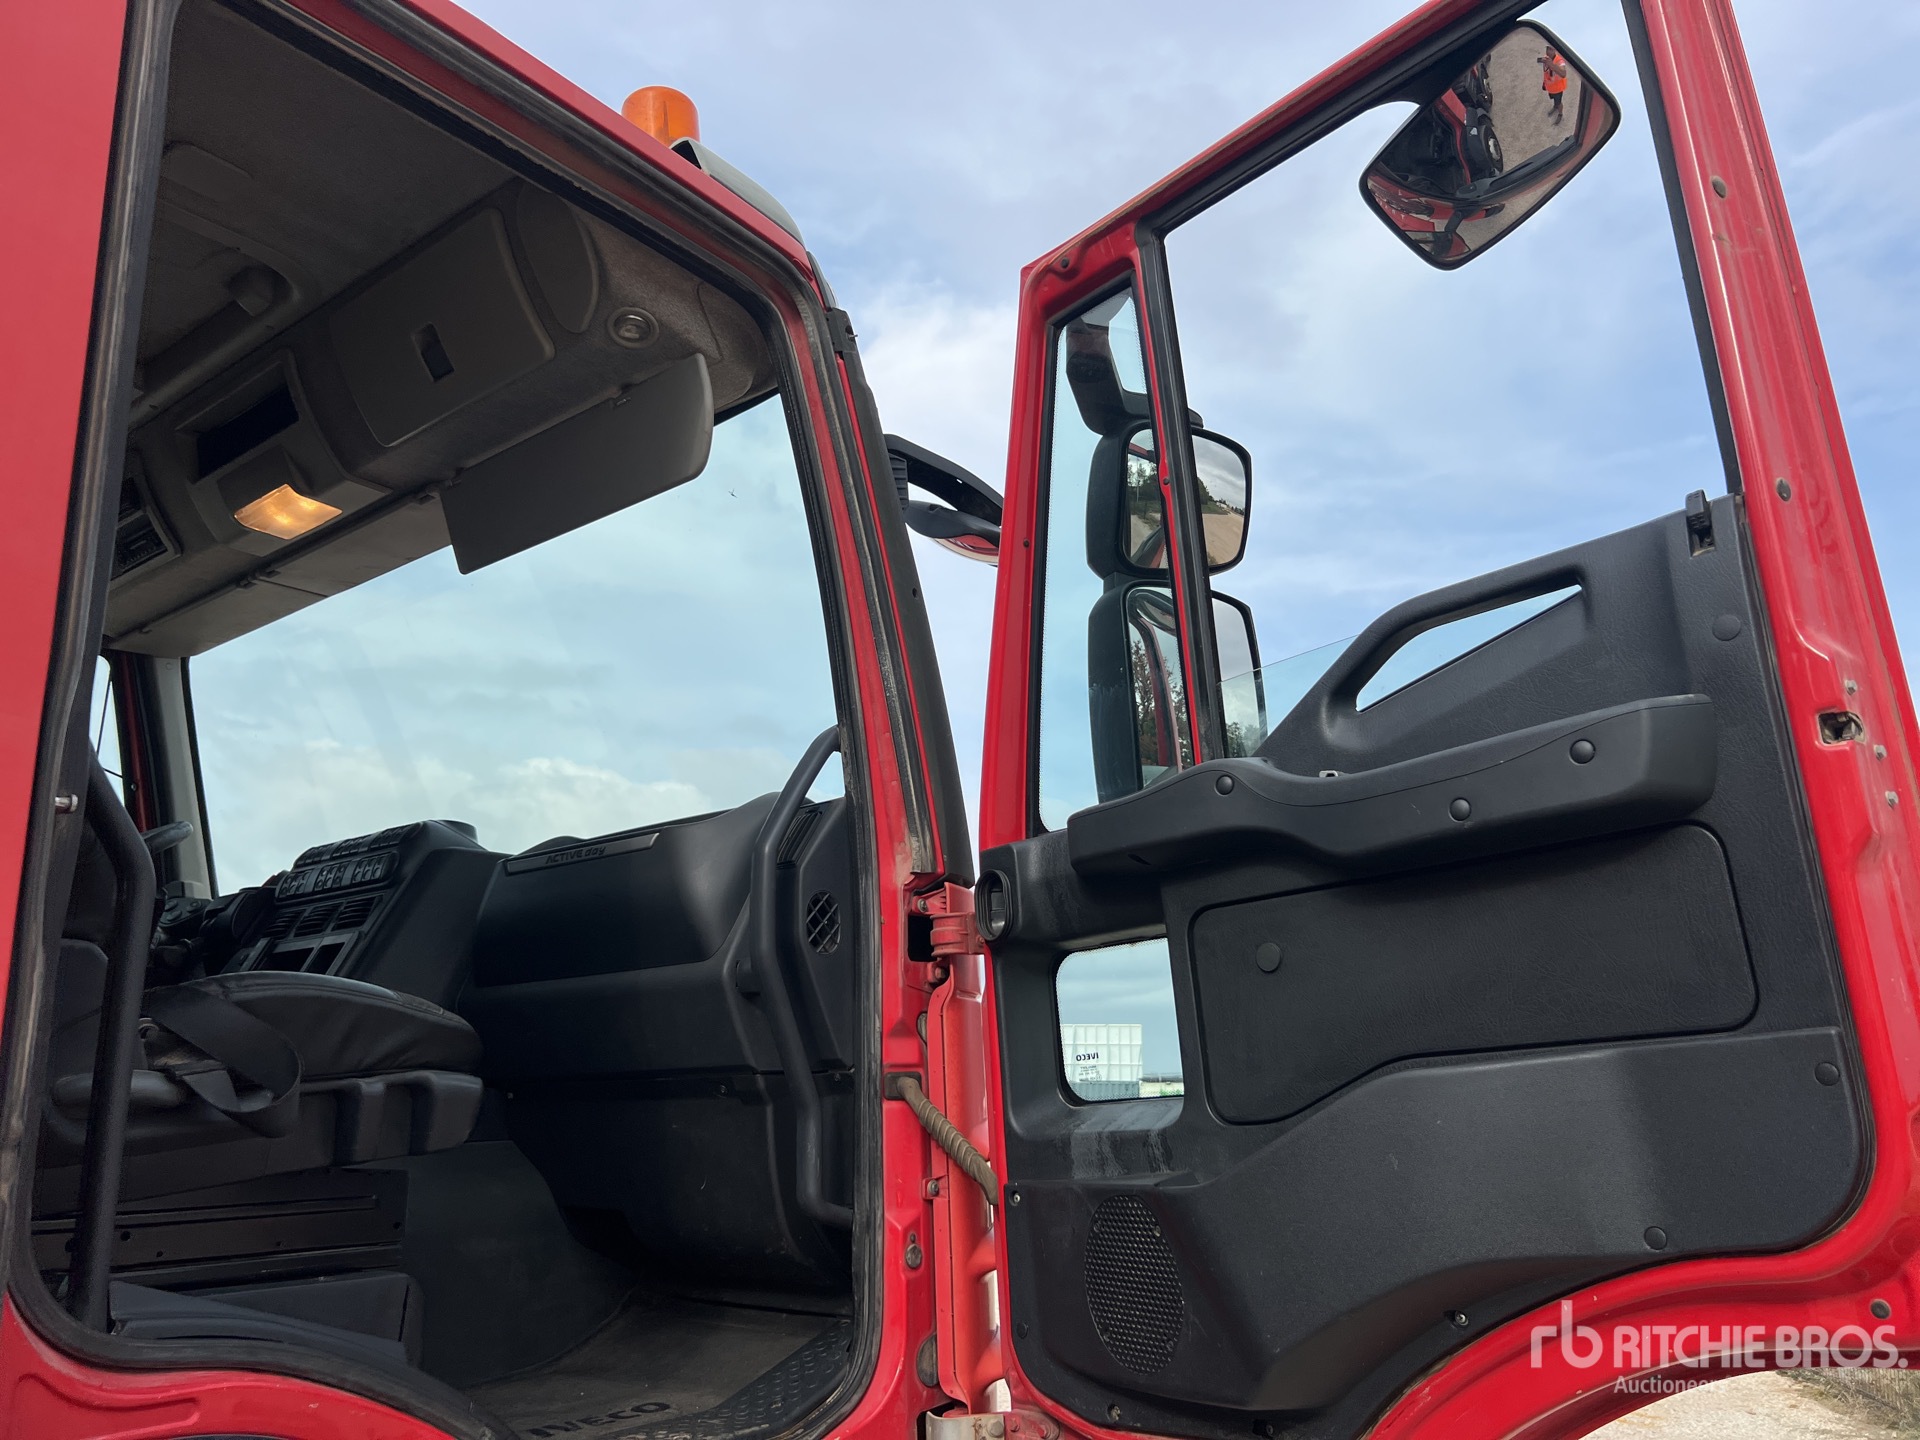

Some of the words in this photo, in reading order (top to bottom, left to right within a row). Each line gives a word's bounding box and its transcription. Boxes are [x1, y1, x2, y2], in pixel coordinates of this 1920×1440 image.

[546, 849, 583, 863] ACTIVE
[584, 846, 606, 856] day
[527, 1402, 671, 1437] IVECO
